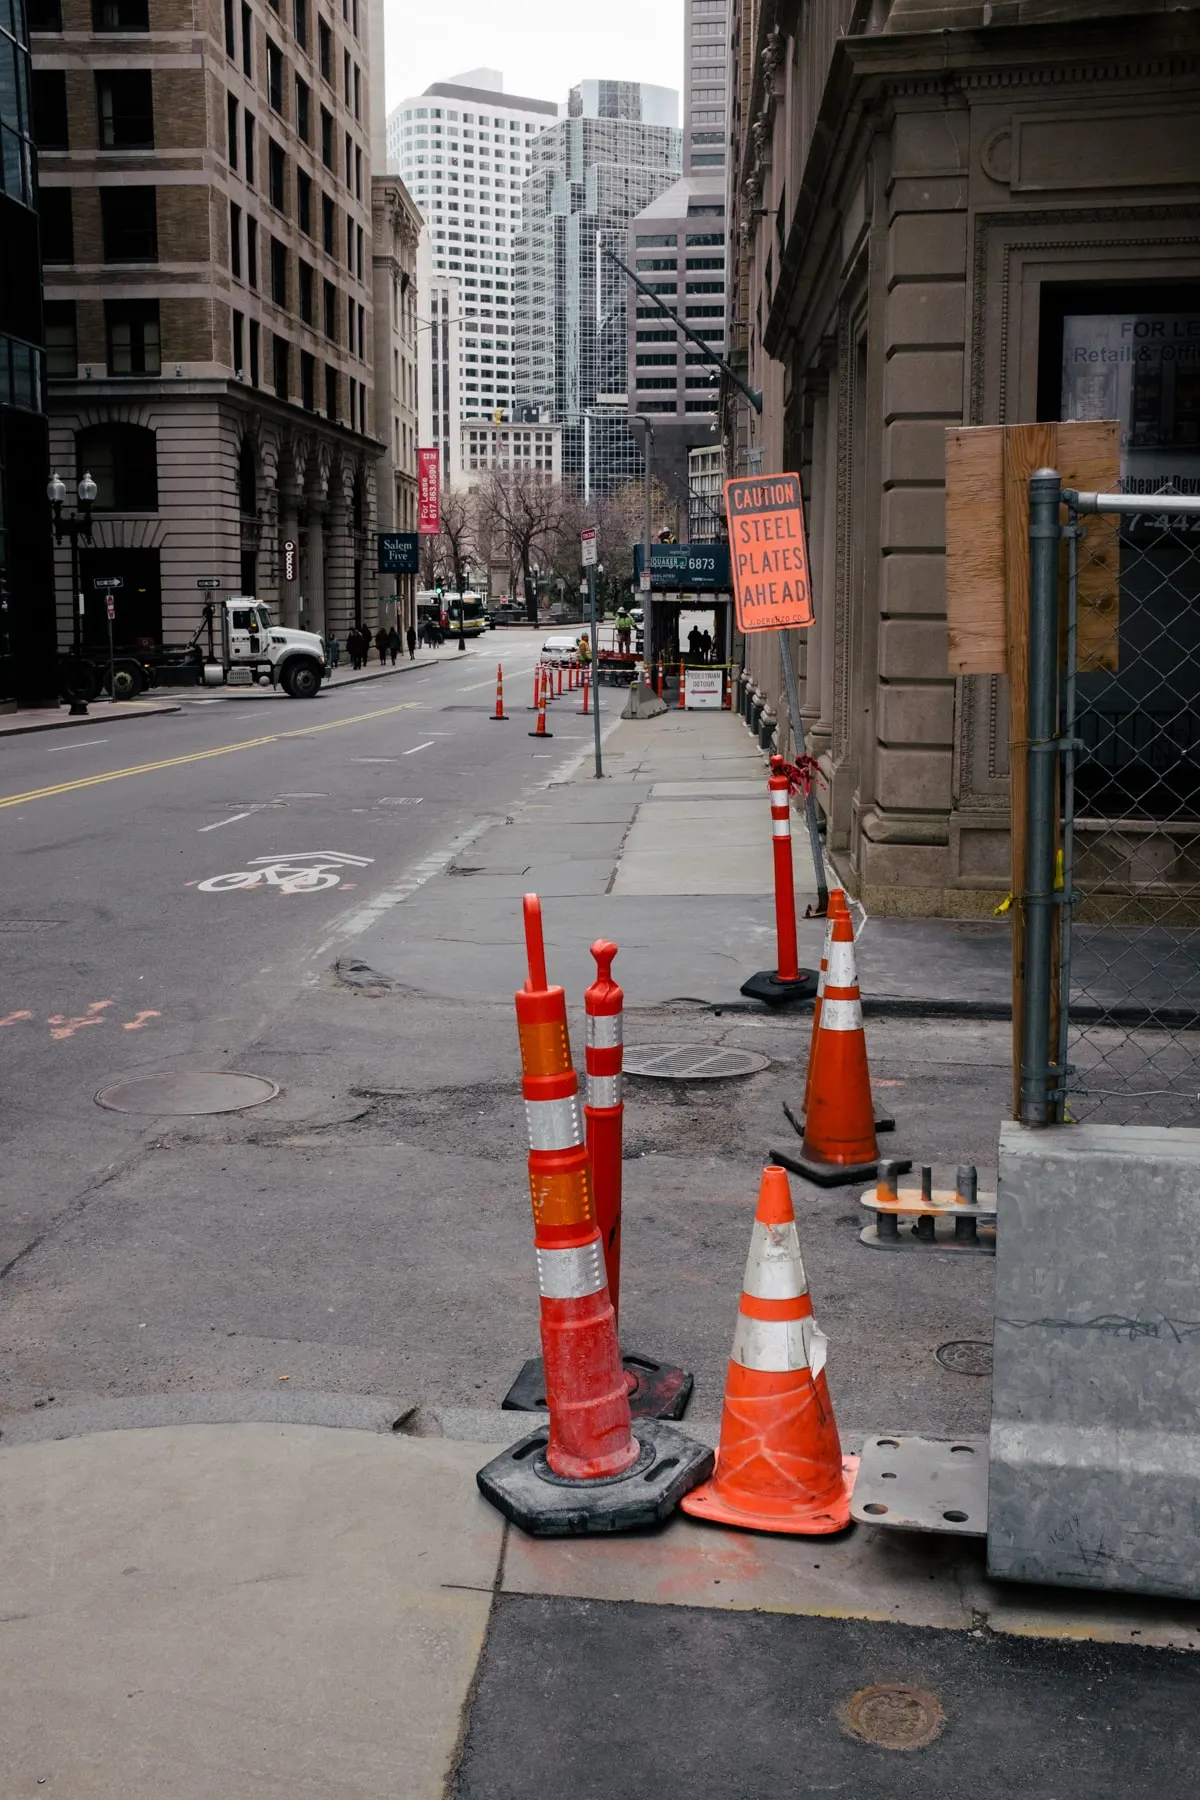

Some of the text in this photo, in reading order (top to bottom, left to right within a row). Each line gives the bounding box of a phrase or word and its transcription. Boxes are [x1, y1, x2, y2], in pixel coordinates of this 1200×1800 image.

[1120, 321, 1166, 338] FOR
[1074, 344, 1200, 362] Retail & Offi
[421, 477, 429, 503] Lease
[734, 483, 795, 509] CAUTION
[421, 508, 429, 519] For
[740, 515, 797, 544] STEEL
[383, 539, 413, 550] Salem
[389, 550, 408, 561] Five
[688, 558, 715, 570] 6873
[738, 546, 804, 576] PLATES
[743, 579, 806, 608] AHEAD
[687, 672, 721, 680] PEDESTRIAN
